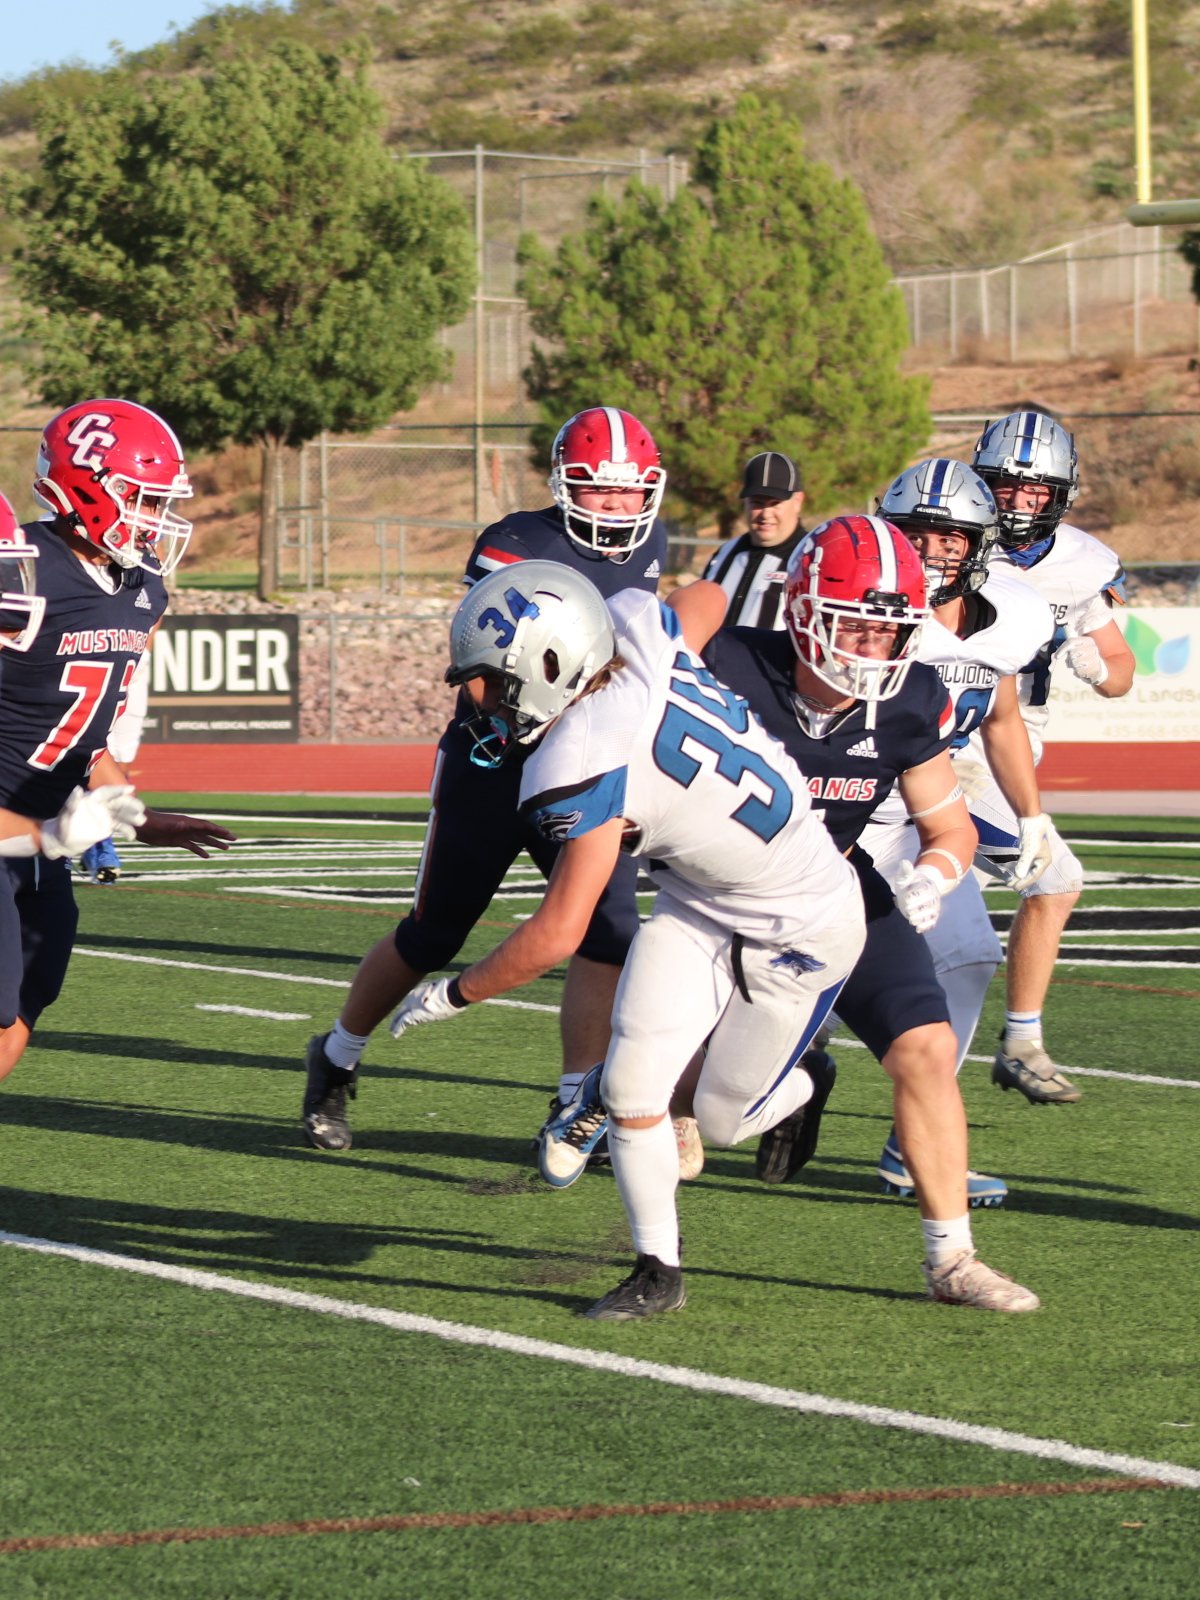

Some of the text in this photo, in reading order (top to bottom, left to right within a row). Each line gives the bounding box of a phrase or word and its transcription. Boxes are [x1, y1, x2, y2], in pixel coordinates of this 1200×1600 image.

[67, 412, 117, 467] CC
[477, 586, 539, 649] 34
[846, 748, 879, 759] adidas
[803, 776, 878, 802] ANGS
